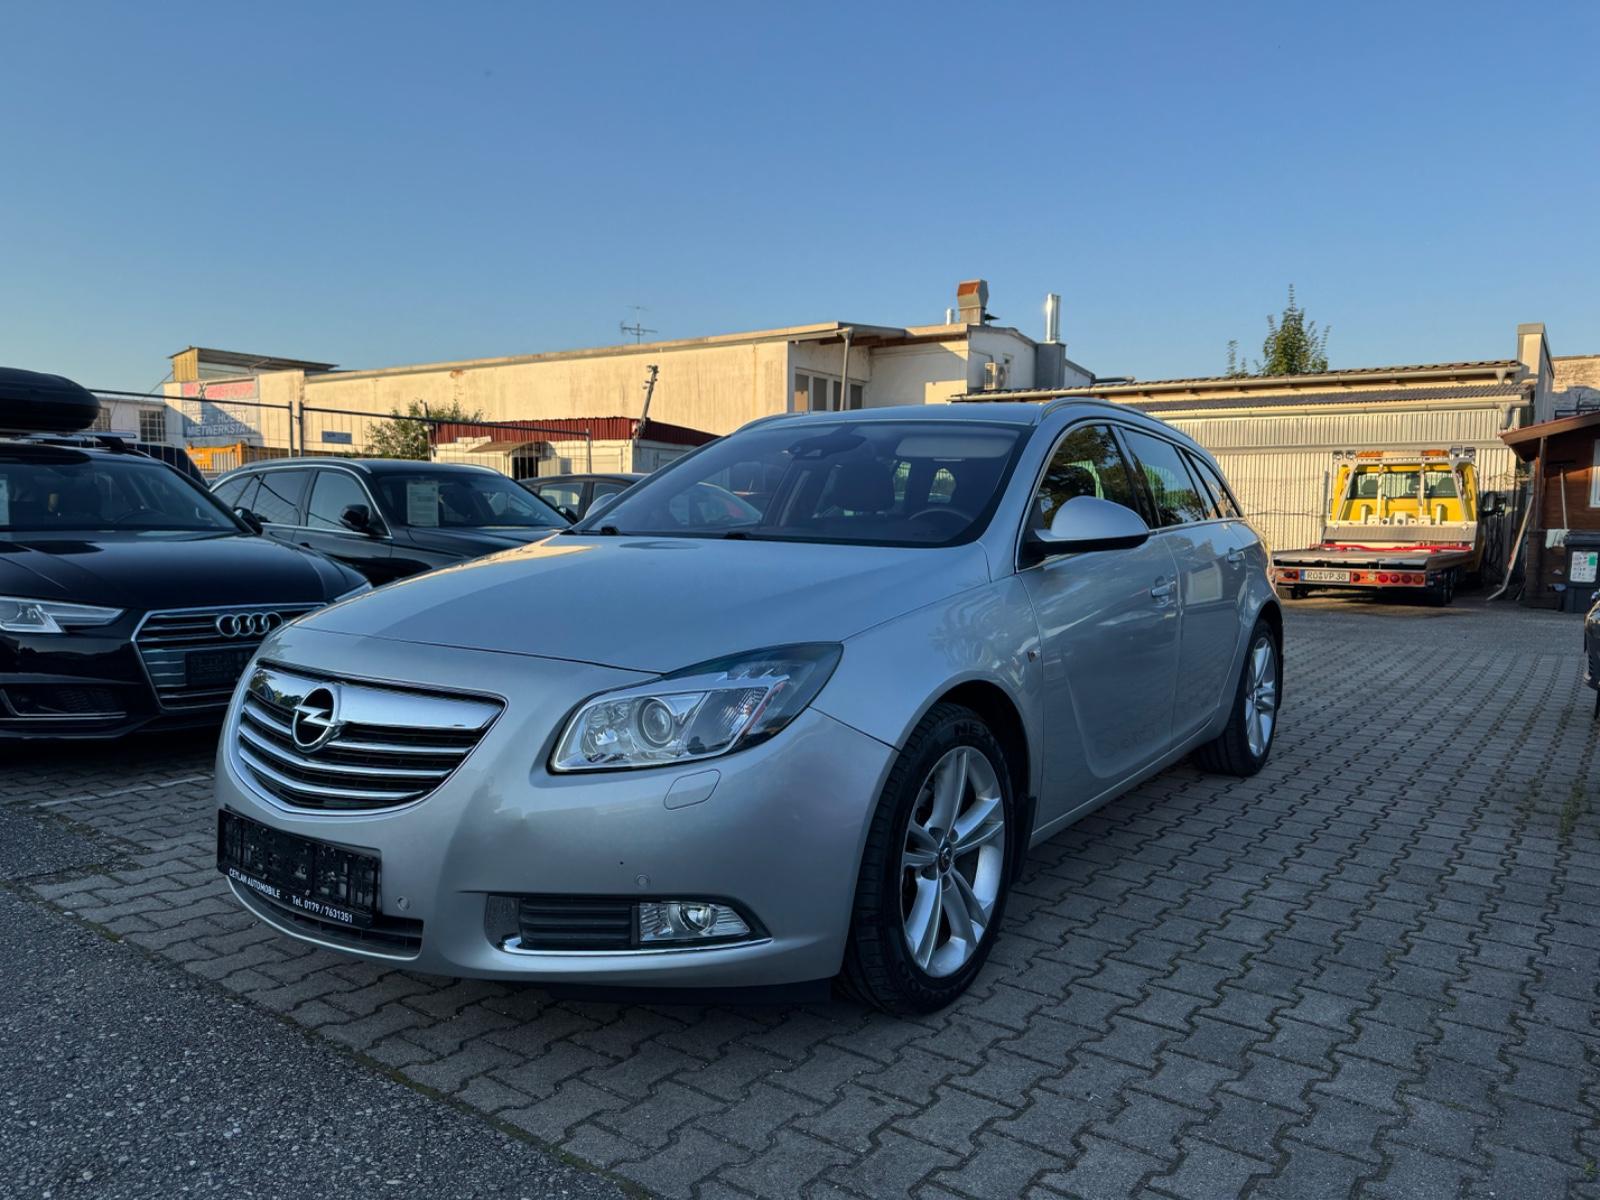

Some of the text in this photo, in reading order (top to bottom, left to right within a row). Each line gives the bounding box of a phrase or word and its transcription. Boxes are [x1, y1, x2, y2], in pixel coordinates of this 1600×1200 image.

[247, 877, 281, 899] AUTOMOBILE
[304, 900, 319, 913] 0179
[325, 906, 353, 924] 7631351
